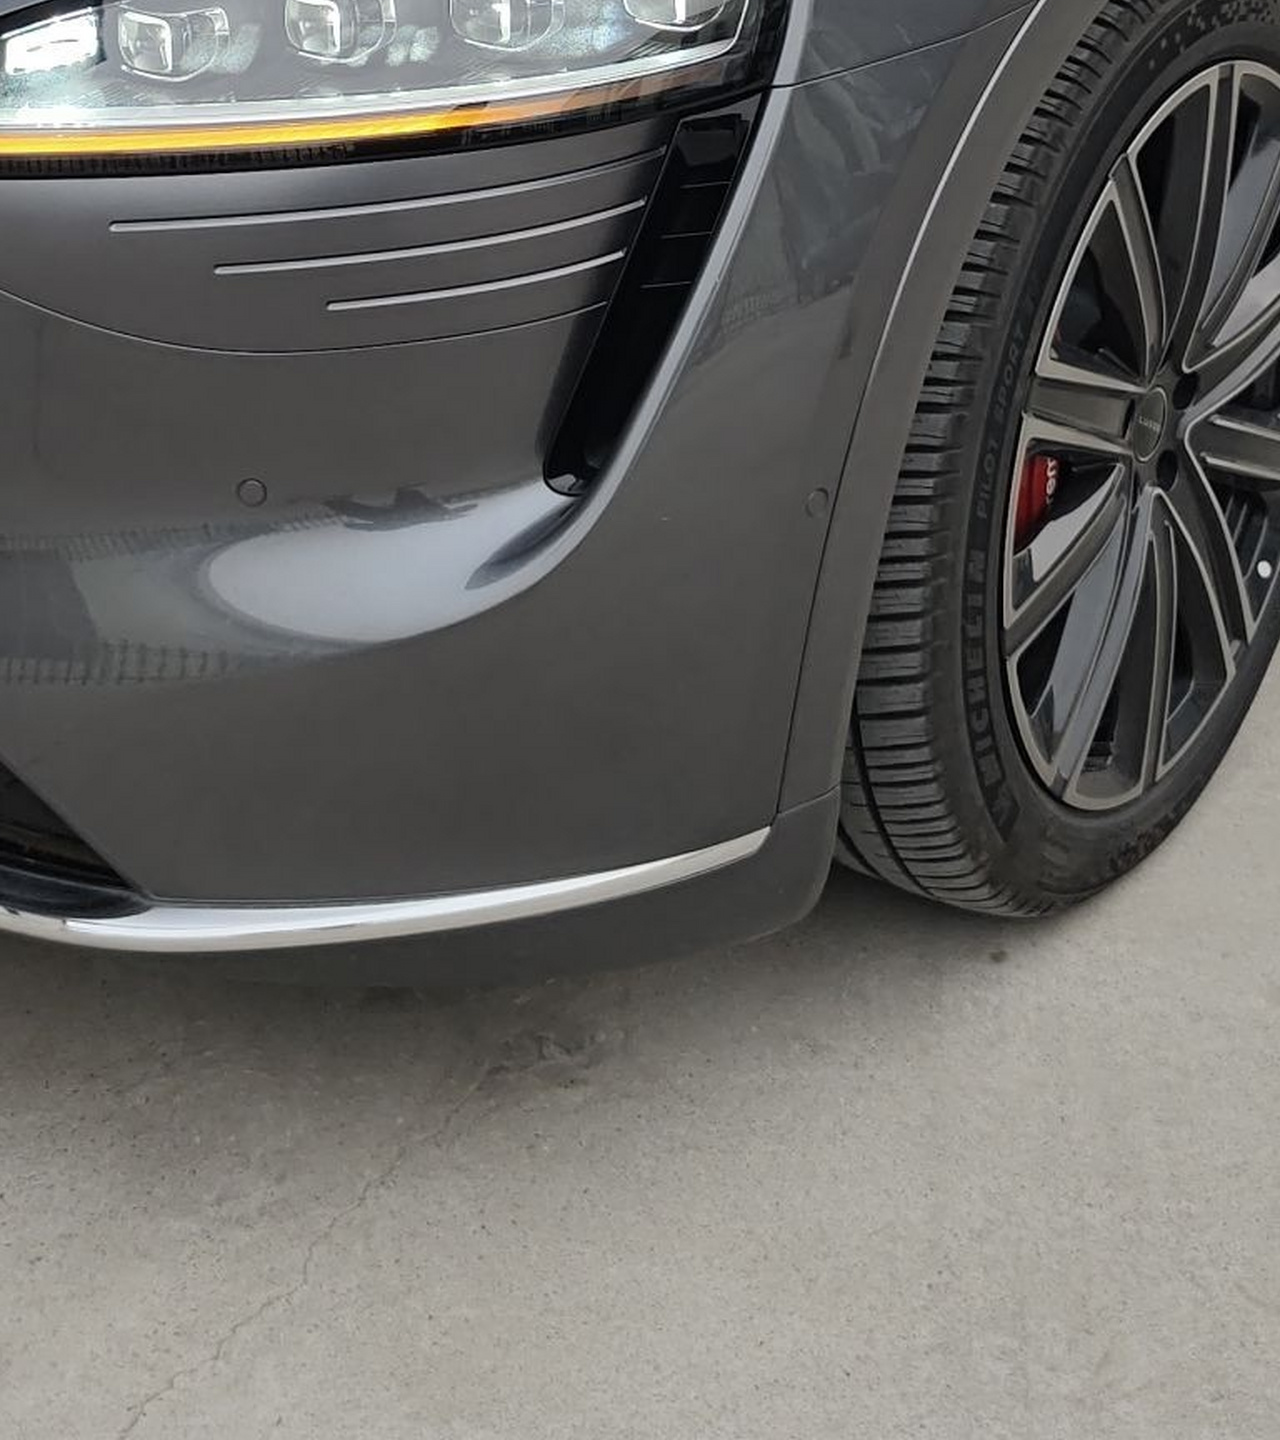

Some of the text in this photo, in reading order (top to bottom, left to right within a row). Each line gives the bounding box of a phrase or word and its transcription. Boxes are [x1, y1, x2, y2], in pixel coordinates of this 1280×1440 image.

[975, 319, 1025, 520] PILOT SPORT
[963, 549, 1003, 787] MICHELIN
